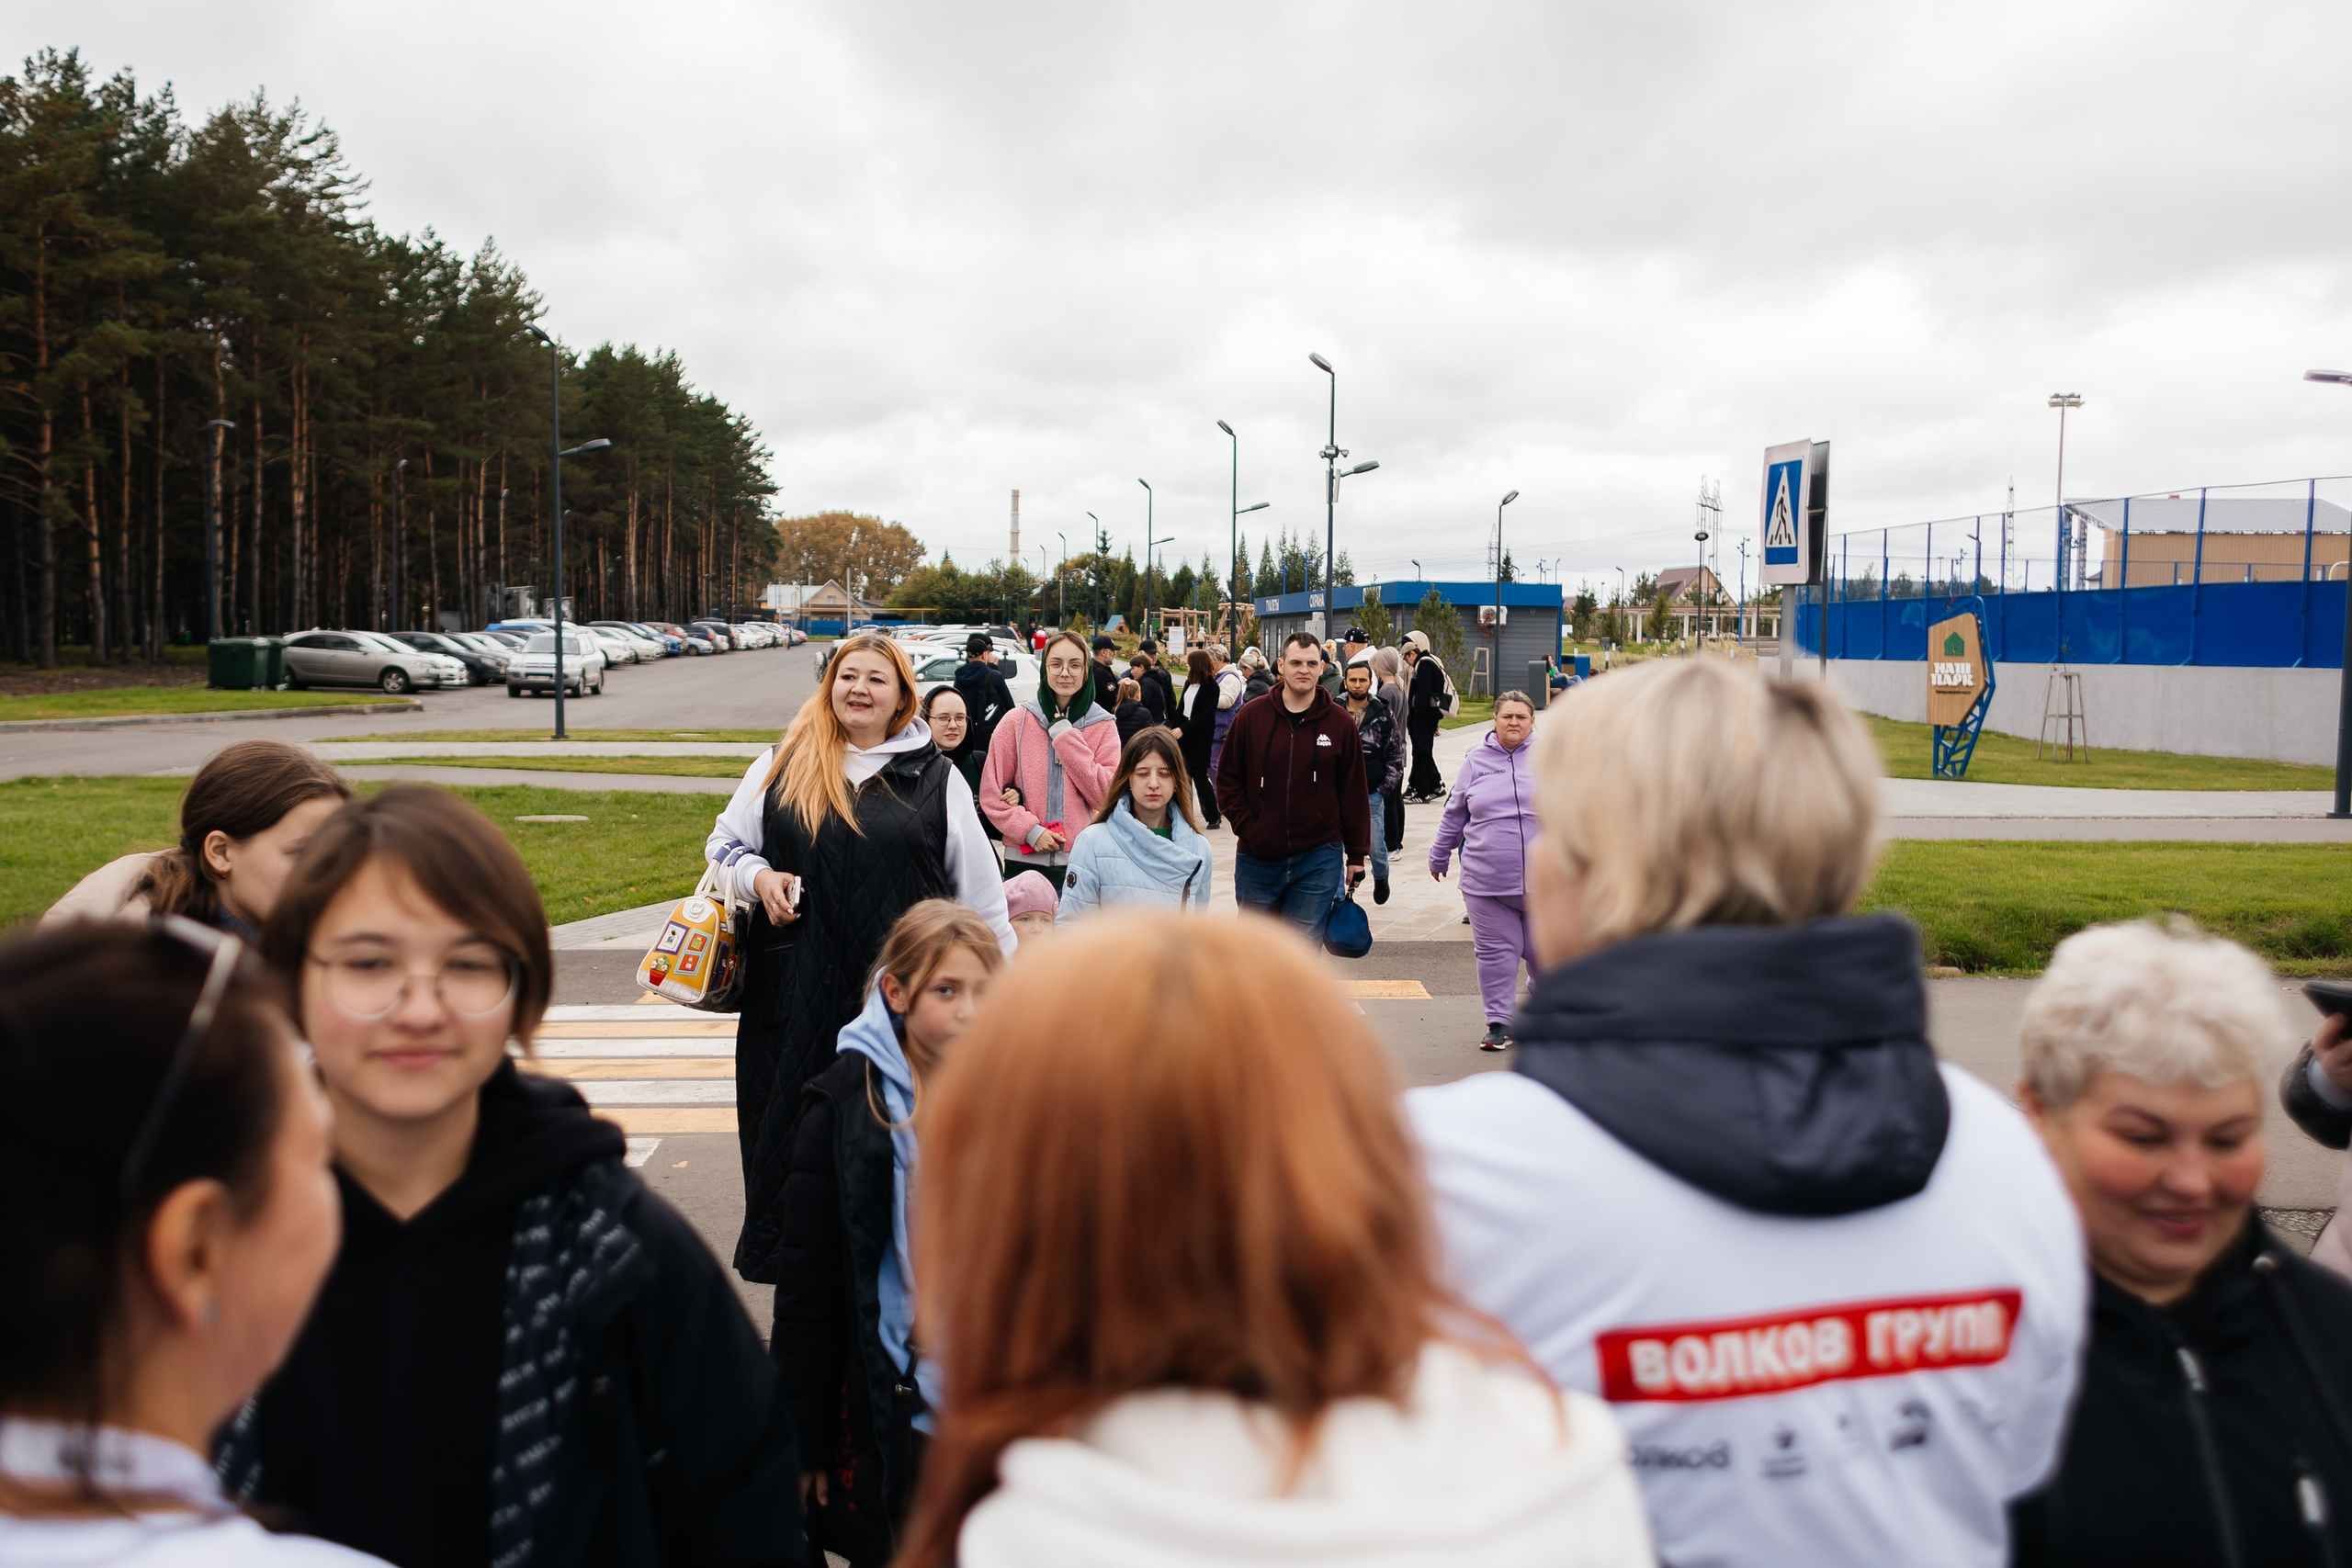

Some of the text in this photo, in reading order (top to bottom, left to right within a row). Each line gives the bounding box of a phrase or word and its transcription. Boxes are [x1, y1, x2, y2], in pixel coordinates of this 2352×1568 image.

[1309, 592, 1325, 608] ОХРАНА
[1933, 662, 1972, 674] НАШ
[1930, 673, 1974, 686] ПАРК
[1629, 1316, 1850, 1393] ВОЛКОВ
